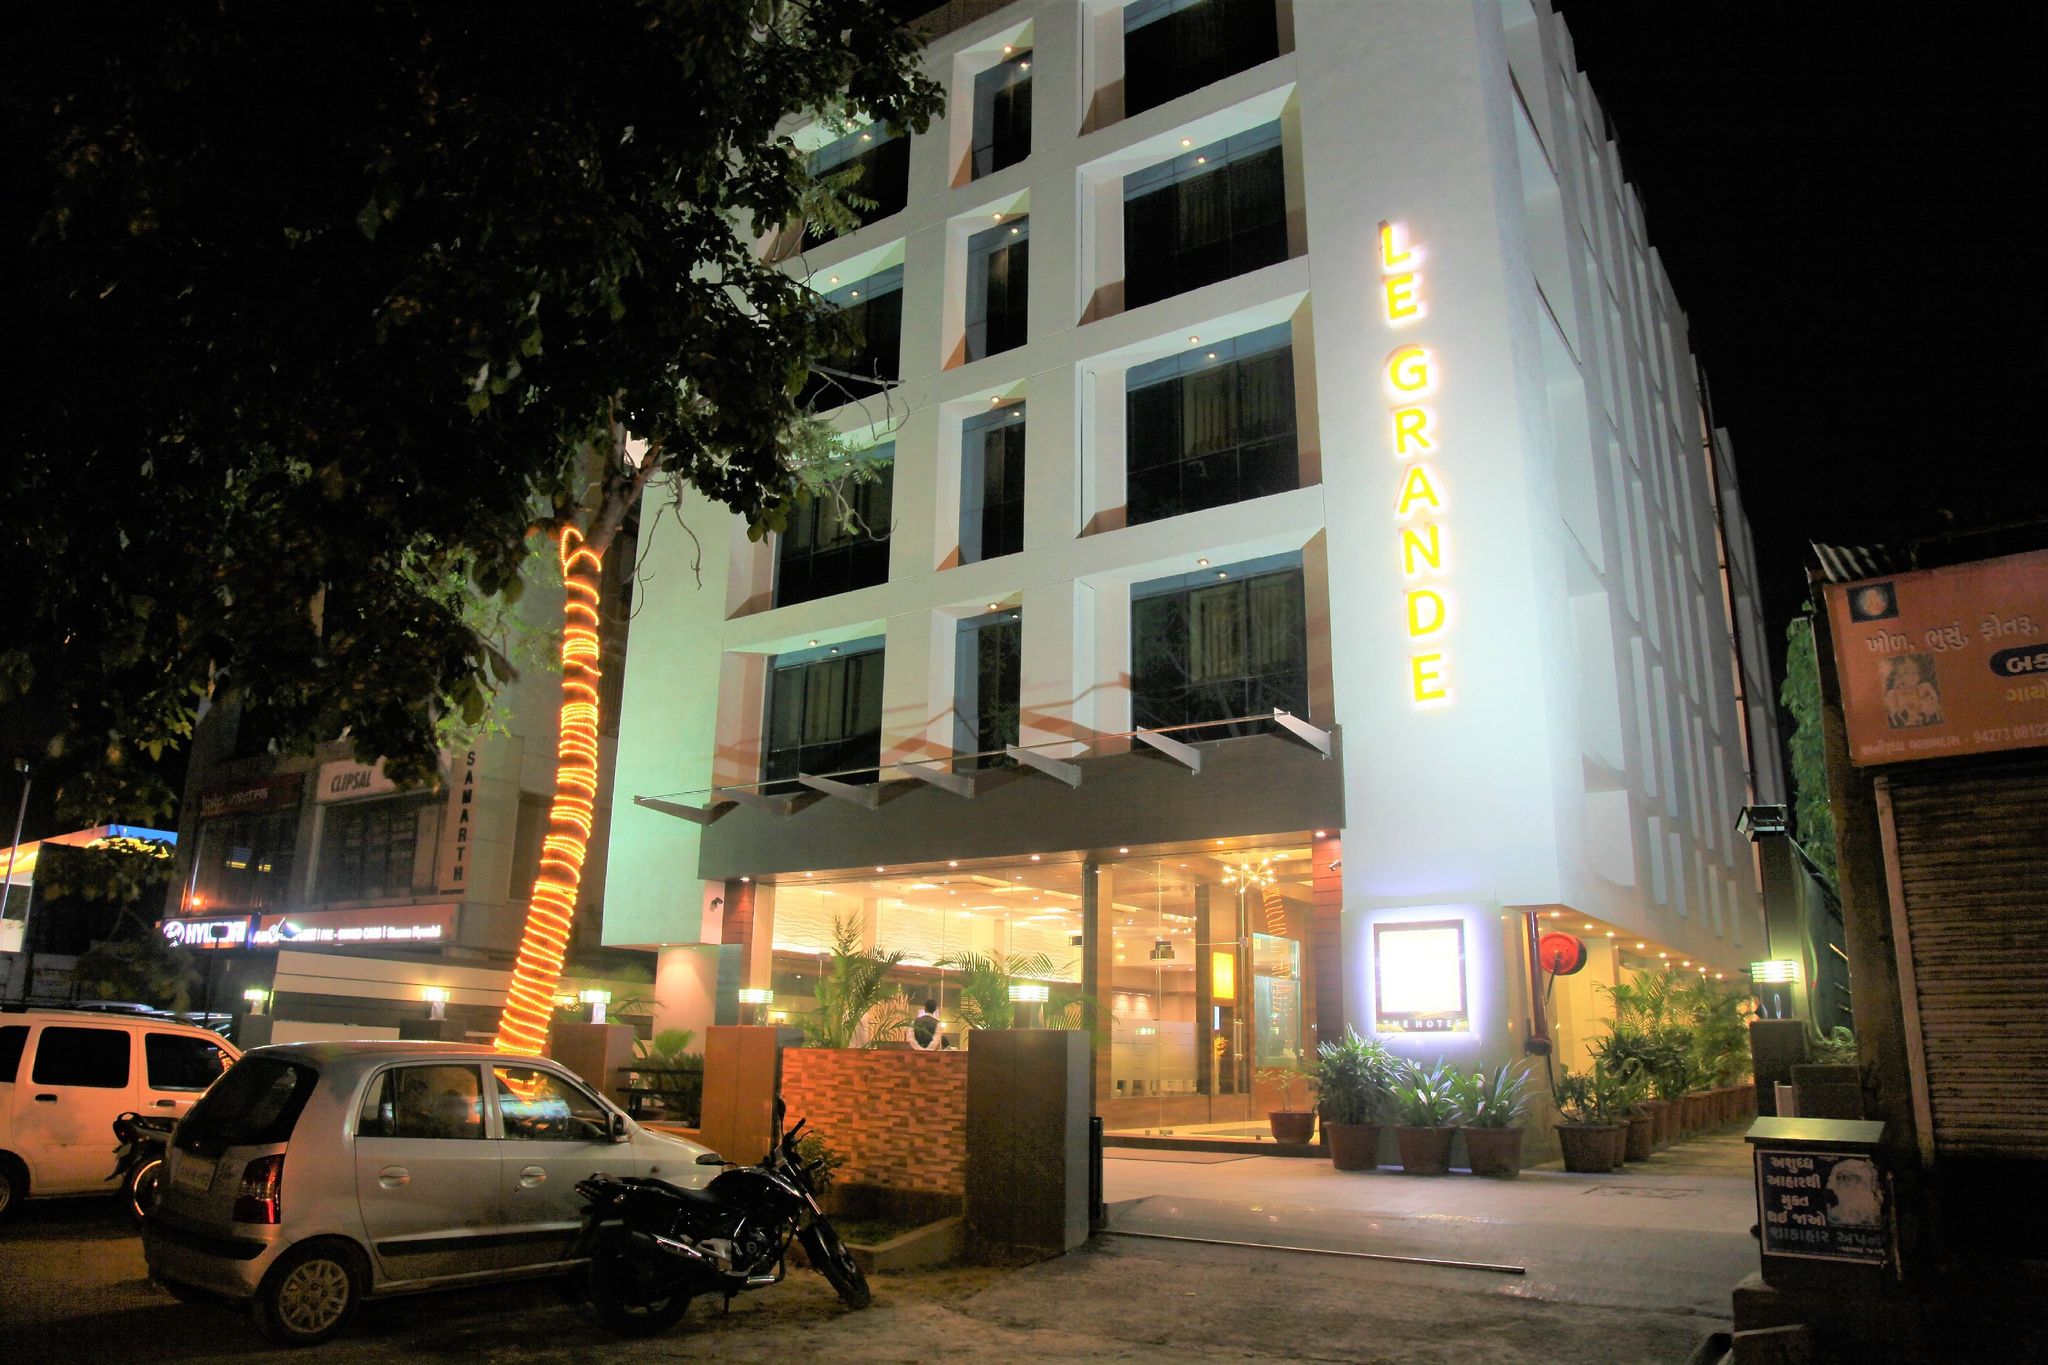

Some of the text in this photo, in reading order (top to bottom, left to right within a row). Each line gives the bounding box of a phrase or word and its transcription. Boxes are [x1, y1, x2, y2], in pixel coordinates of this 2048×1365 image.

[1380, 221, 1447, 702] LE GRANDE
[331, 771, 371, 792] CLIPSAL
[453, 751, 475, 881] SAMARTH
[1382, 1020, 1409, 1028] THE
